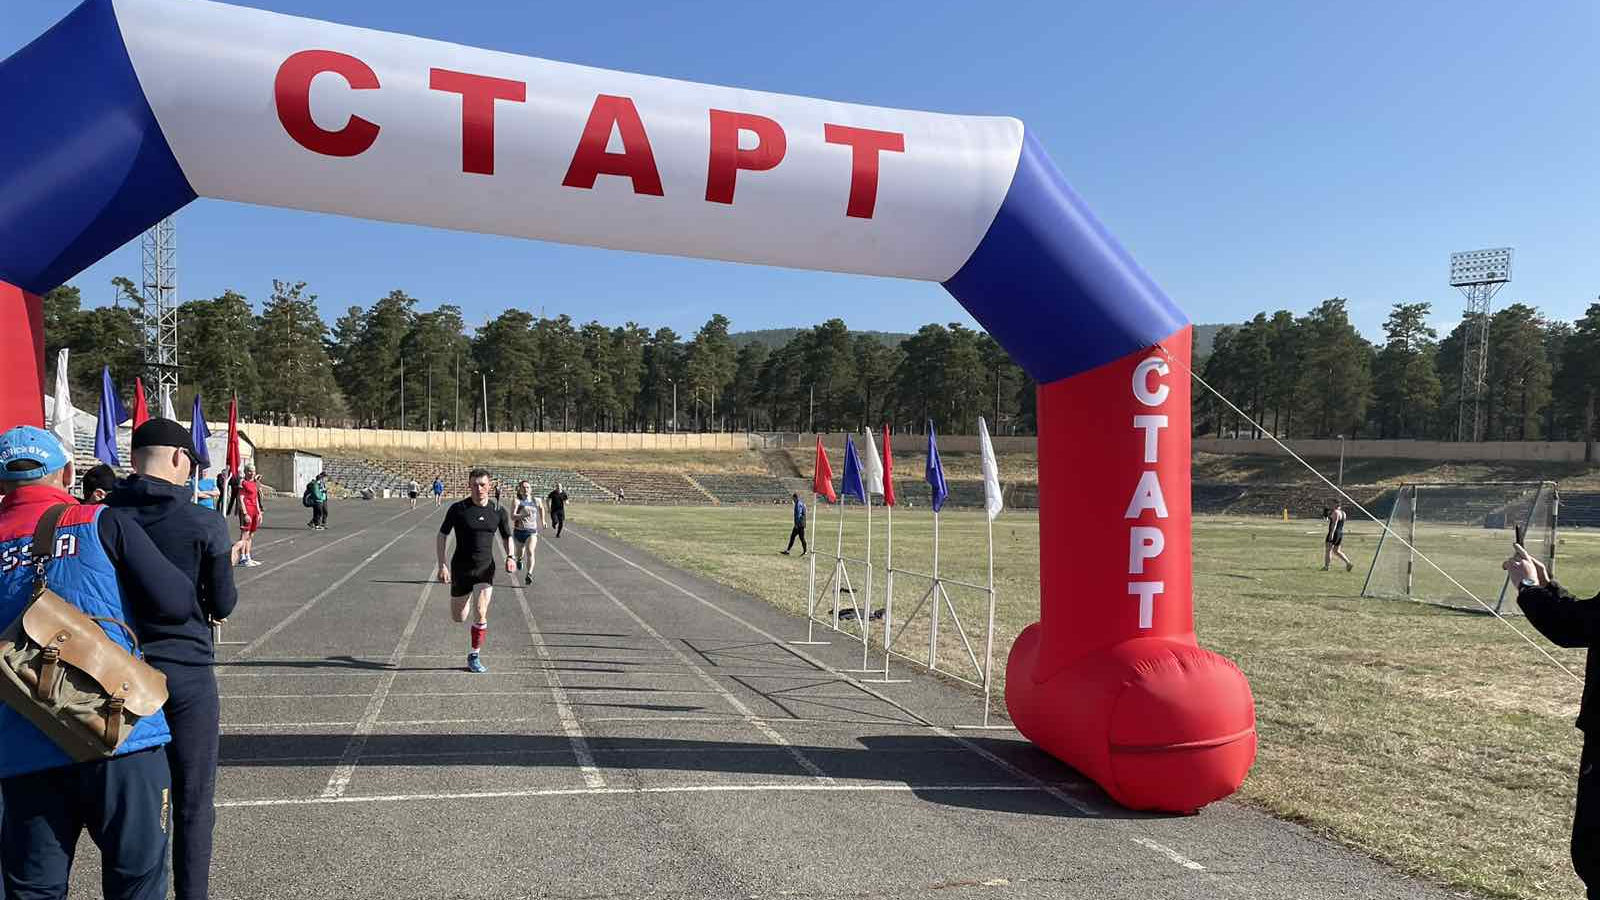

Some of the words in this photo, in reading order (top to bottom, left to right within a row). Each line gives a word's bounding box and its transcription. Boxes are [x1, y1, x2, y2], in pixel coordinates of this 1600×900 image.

[274, 49, 905, 219] СТАРТ
[2, 533, 77, 571] SSA
[1123, 356, 1171, 629] СТАРТ
